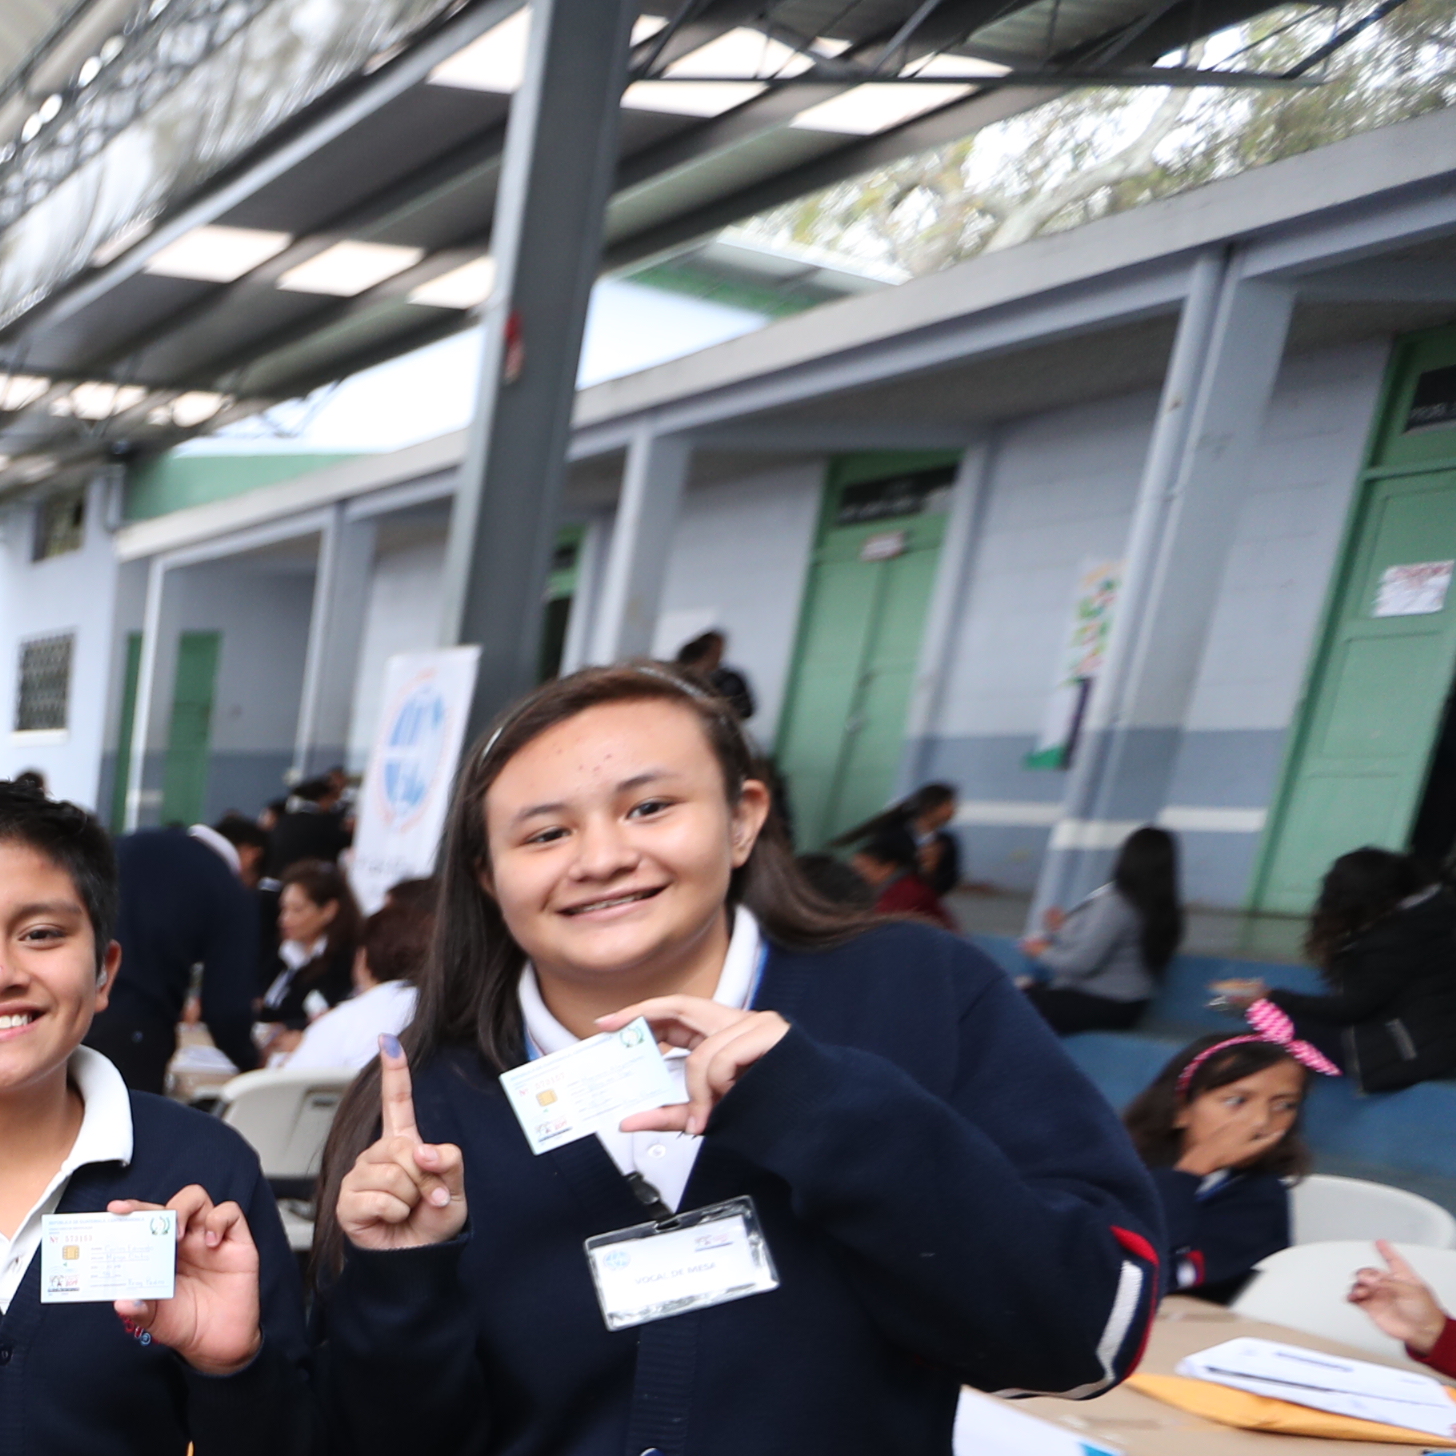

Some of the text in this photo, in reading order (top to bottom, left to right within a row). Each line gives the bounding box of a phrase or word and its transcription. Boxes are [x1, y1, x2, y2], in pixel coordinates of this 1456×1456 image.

[635, 1262, 717, 1285] VOCAL DE MESA
